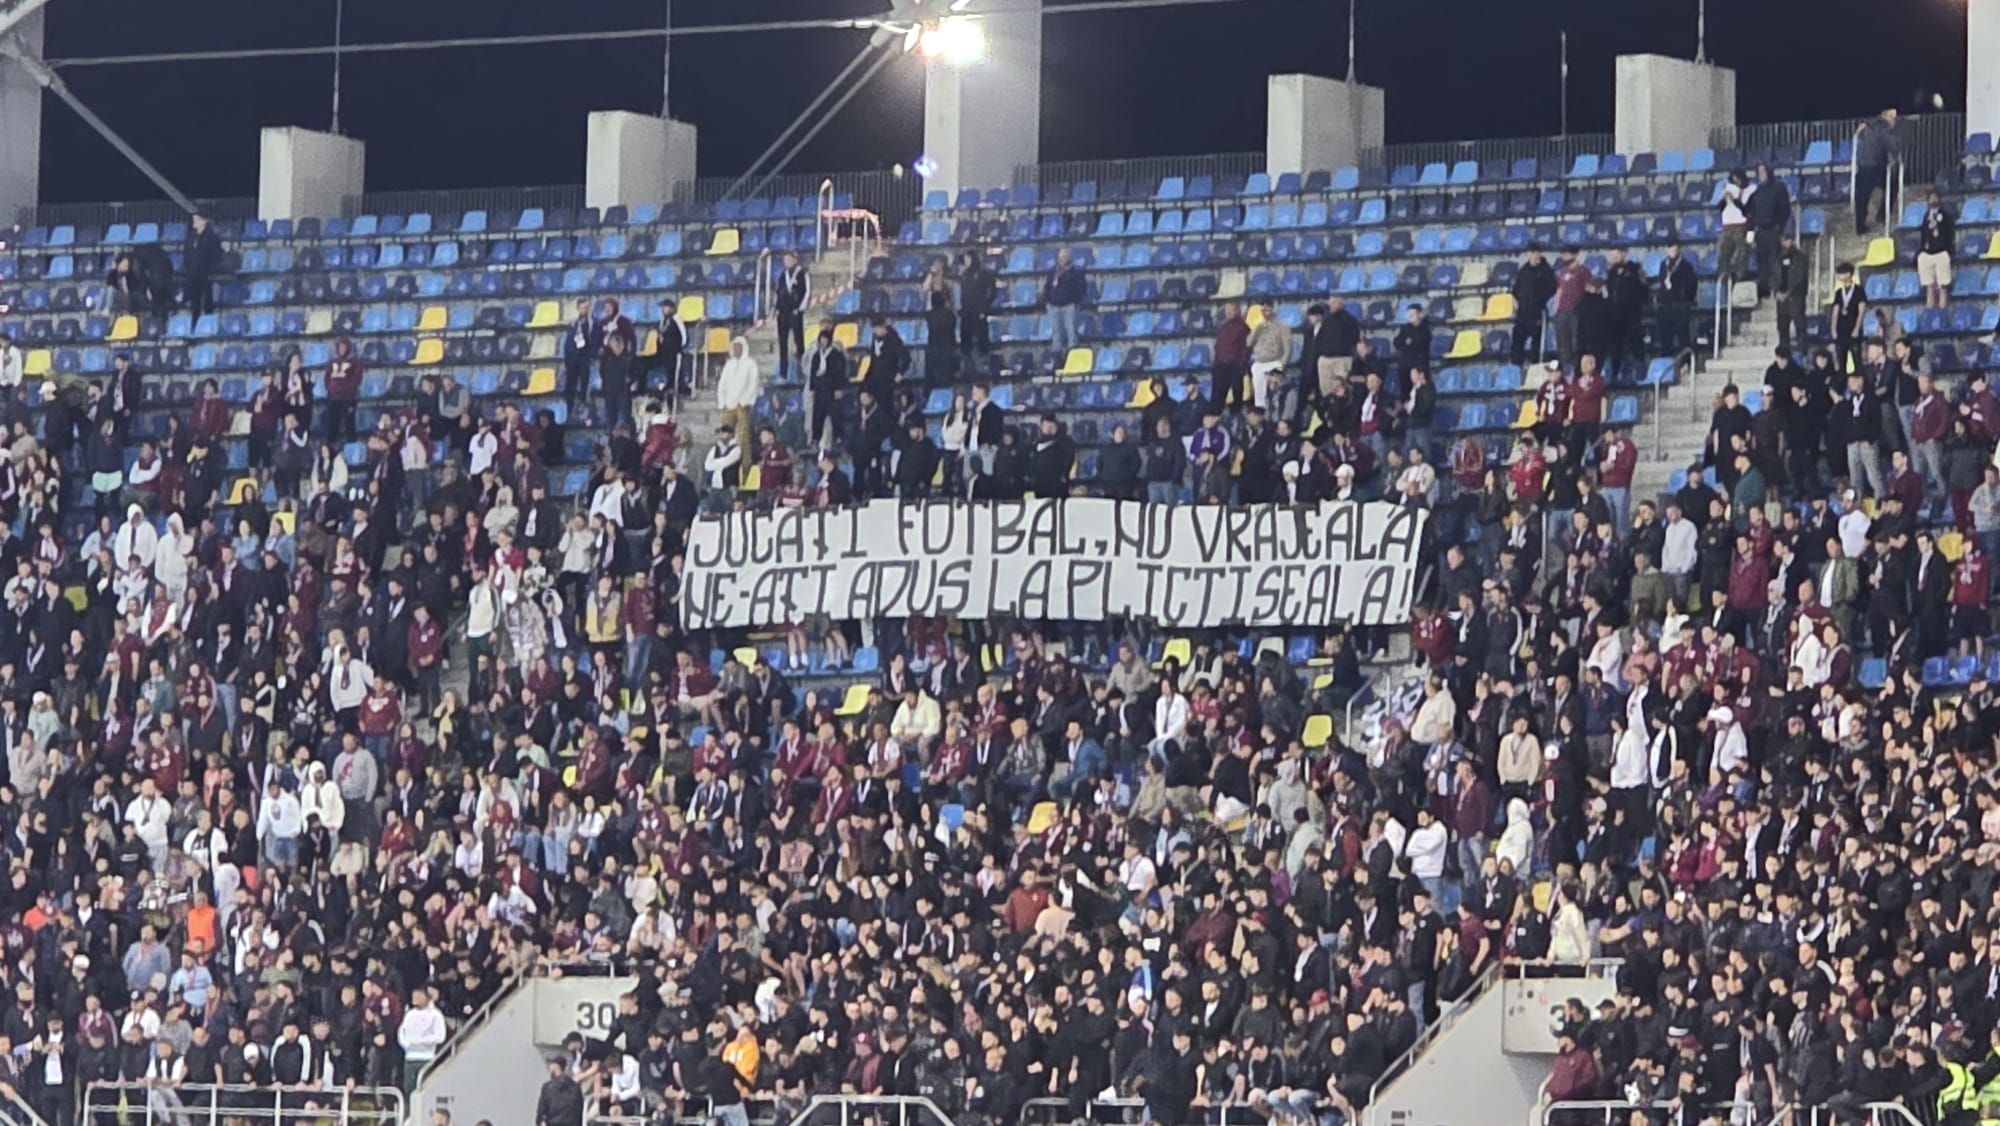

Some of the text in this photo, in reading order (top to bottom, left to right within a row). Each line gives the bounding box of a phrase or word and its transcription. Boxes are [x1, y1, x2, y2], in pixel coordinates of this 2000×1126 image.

[1115, 500, 1173, 558] NU
[849, 558, 973, 618] ADUS
[988, 557, 1052, 618] LA
[577, 1002, 616, 1030] 30
